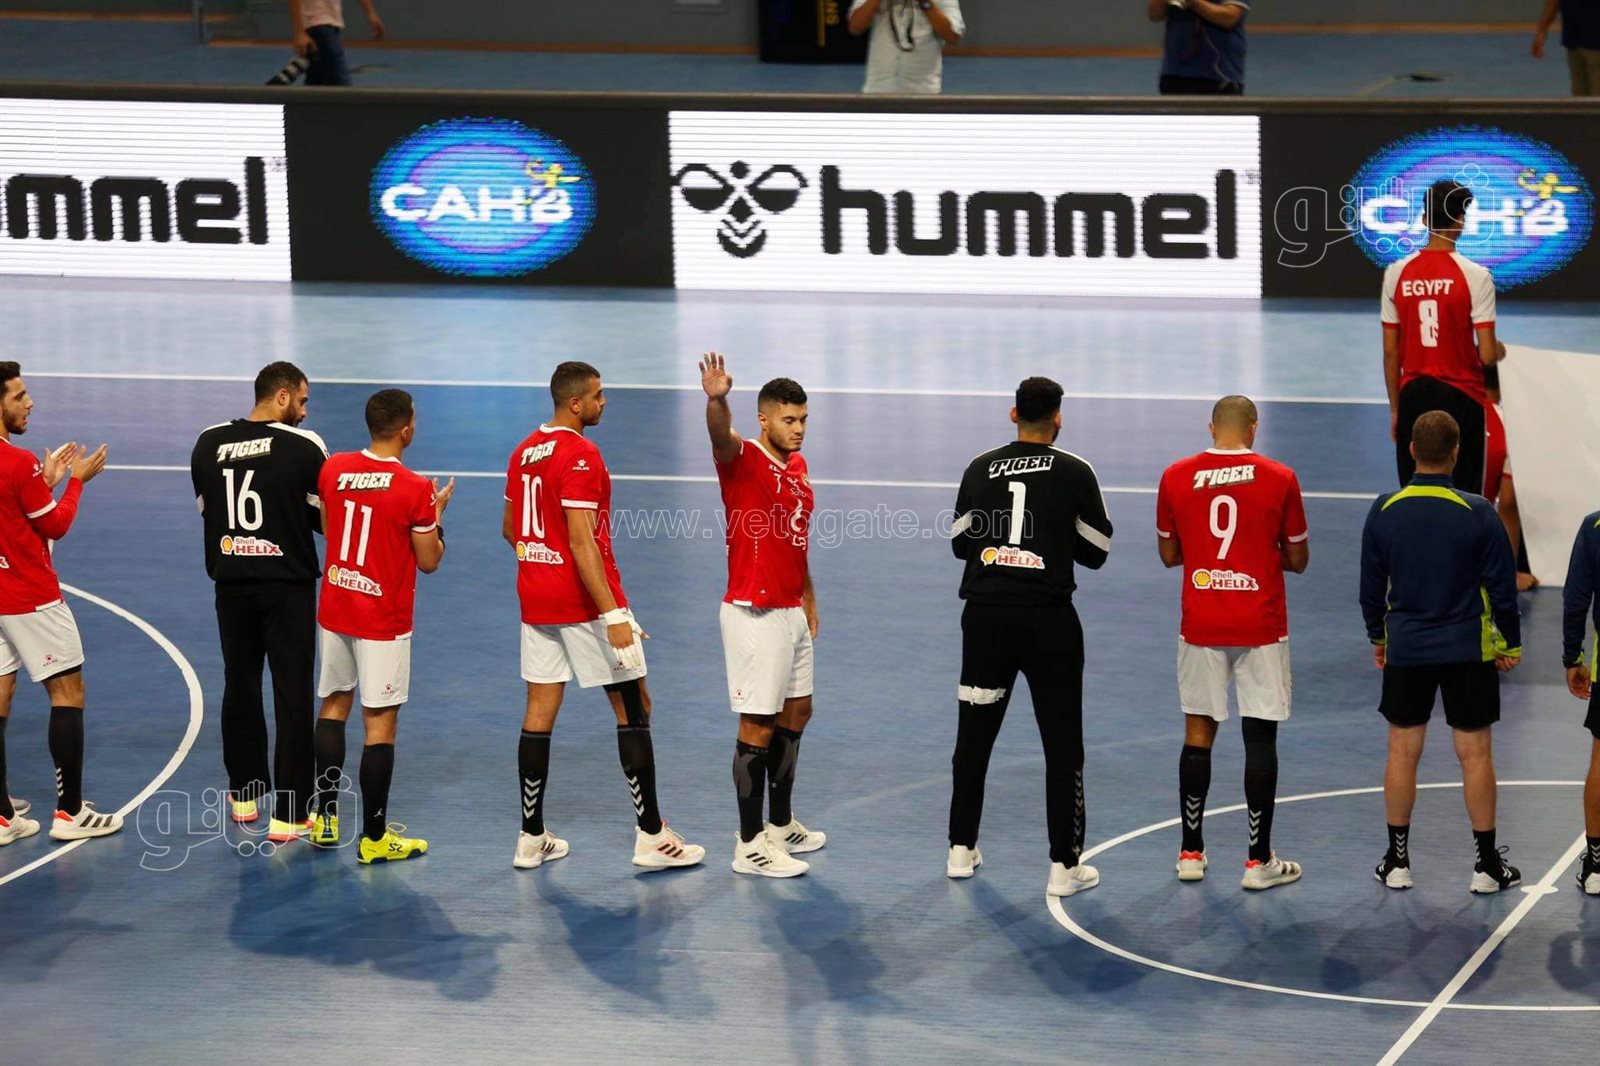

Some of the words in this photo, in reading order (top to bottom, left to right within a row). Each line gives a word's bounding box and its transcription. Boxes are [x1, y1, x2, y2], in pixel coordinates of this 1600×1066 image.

[4, 156, 271, 246] mmel
[381, 183, 573, 224] CAHB
[820, 164, 1236, 259] hummel
[1402, 279, 1454, 297] EGYPT
[1418, 299, 1440, 347] 8
[217, 437, 273, 463] TIGER
[988, 455, 1054, 479] TIGER
[1193, 465, 1256, 490] TIGER
[337, 472, 394, 491] TIGER
[222, 468, 264, 531] 16
[521, 474, 545, 539] 10
[1008, 481, 1026, 545] 1
[339, 499, 373, 567] 11
[1209, 494, 1238, 560] 9
[235, 537, 255, 546] Shell
[235, 545, 280, 555] HELIX
[999, 546, 1018, 555] Shell
[998, 555, 1042, 567] HELIX
[340, 568, 358, 579] Shell
[1212, 571, 1232, 579] Shell
[1212, 579, 1256, 589] HELIX
[340, 577, 380, 595] HELIX
